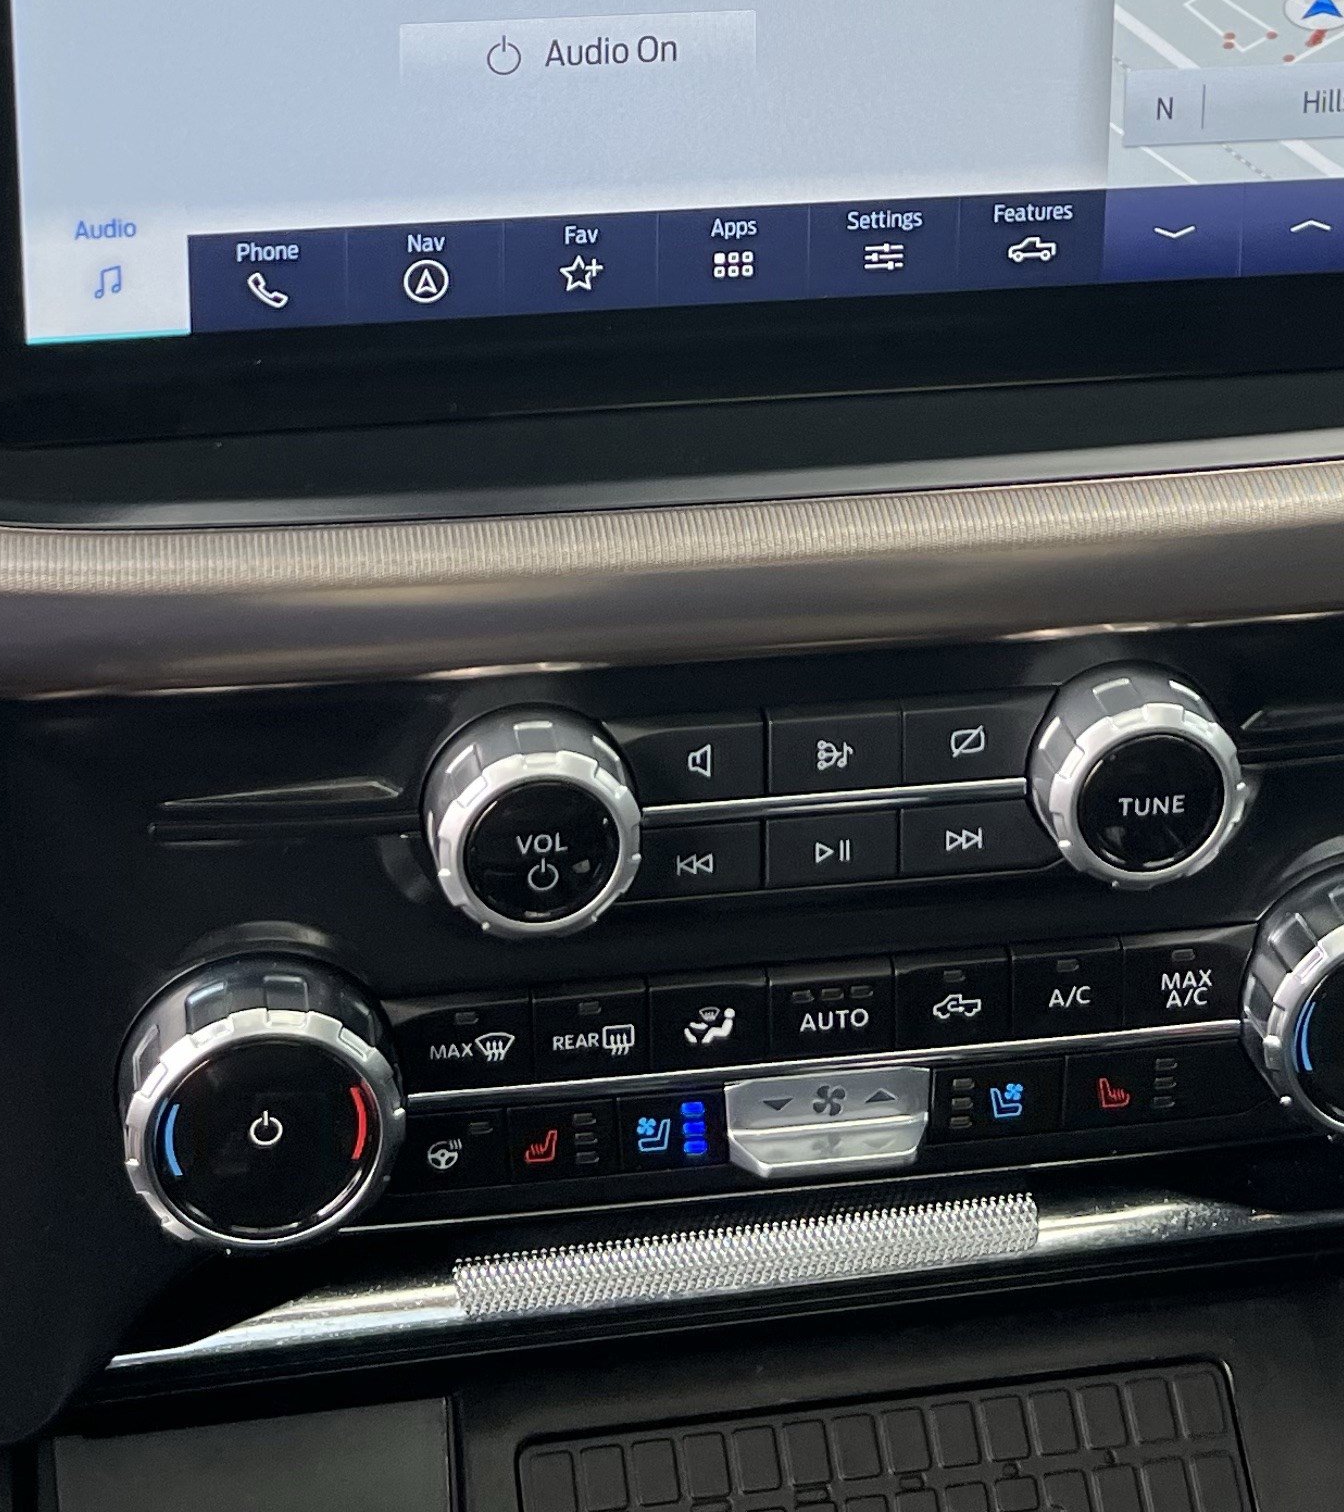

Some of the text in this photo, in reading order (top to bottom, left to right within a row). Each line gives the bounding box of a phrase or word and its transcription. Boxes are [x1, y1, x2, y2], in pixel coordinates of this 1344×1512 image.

[544, 35, 678, 68] Audio On
[1156, 96, 1174, 121] N
[847, 209, 923, 232] Settings
[993, 203, 1073, 223] Features
[74, 218, 137, 240] Audio
[564, 225, 599, 246] Fav
[711, 217, 757, 239] Apps
[236, 242, 299, 263] Phone
[407, 234, 446, 255] Nav
[1118, 794, 1186, 818] TUNE
[515, 832, 568, 856] VOL
[1161, 969, 1212, 992] MAX
[1048, 985, 1091, 1007] A/C
[1166, 987, 1208, 1009] A/C
[799, 1008, 869, 1033] AUTO
[429, 1043, 474, 1061] MAX
[552, 1033, 600, 1052] REAR
